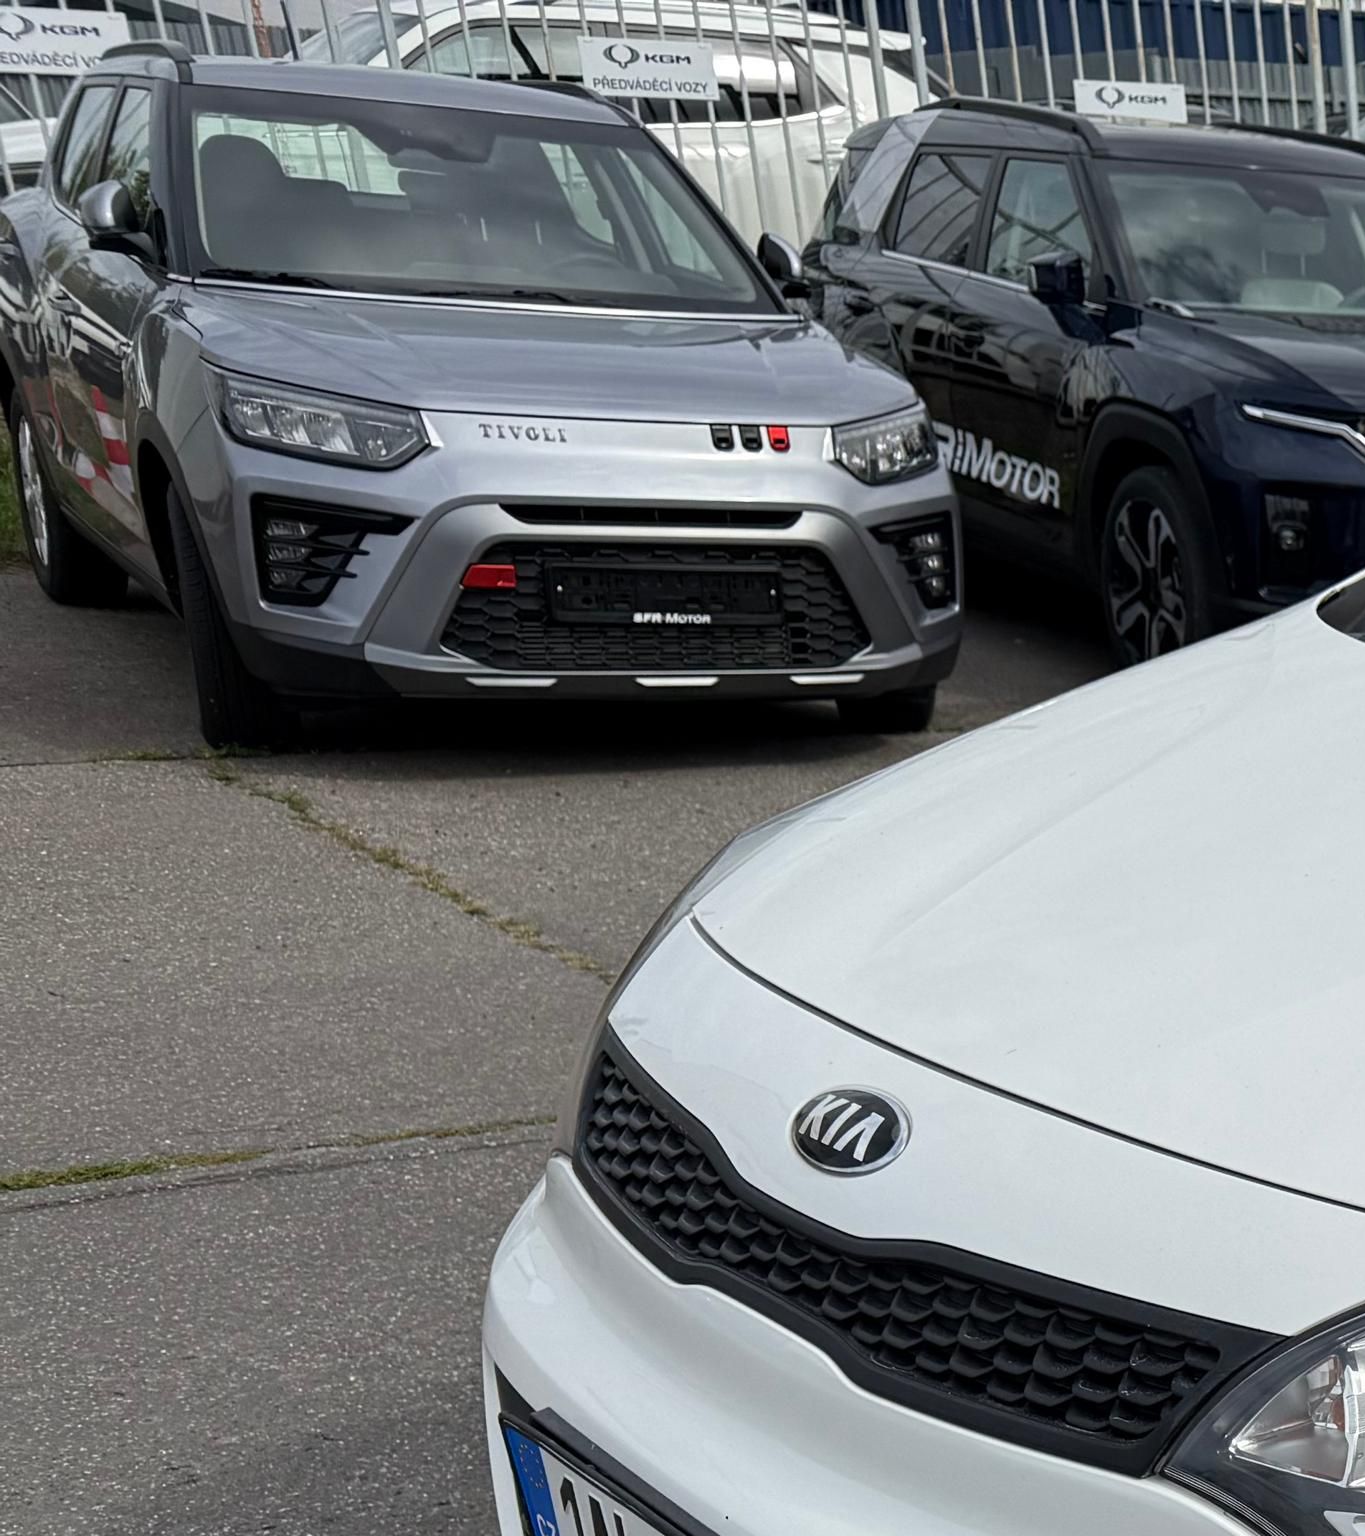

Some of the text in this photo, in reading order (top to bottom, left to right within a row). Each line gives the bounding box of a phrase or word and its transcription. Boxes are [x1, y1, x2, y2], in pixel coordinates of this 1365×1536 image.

[40, 24, 101, 37] KGM
[644, 53, 692, 65] KGM
[592, 75, 708, 94] PŘEDVÁDĚCÍ VOZY
[1128, 94, 1168, 105] KGM
[478, 423, 568, 443] TIVOLI
[798, 1093, 886, 1162] KIA
